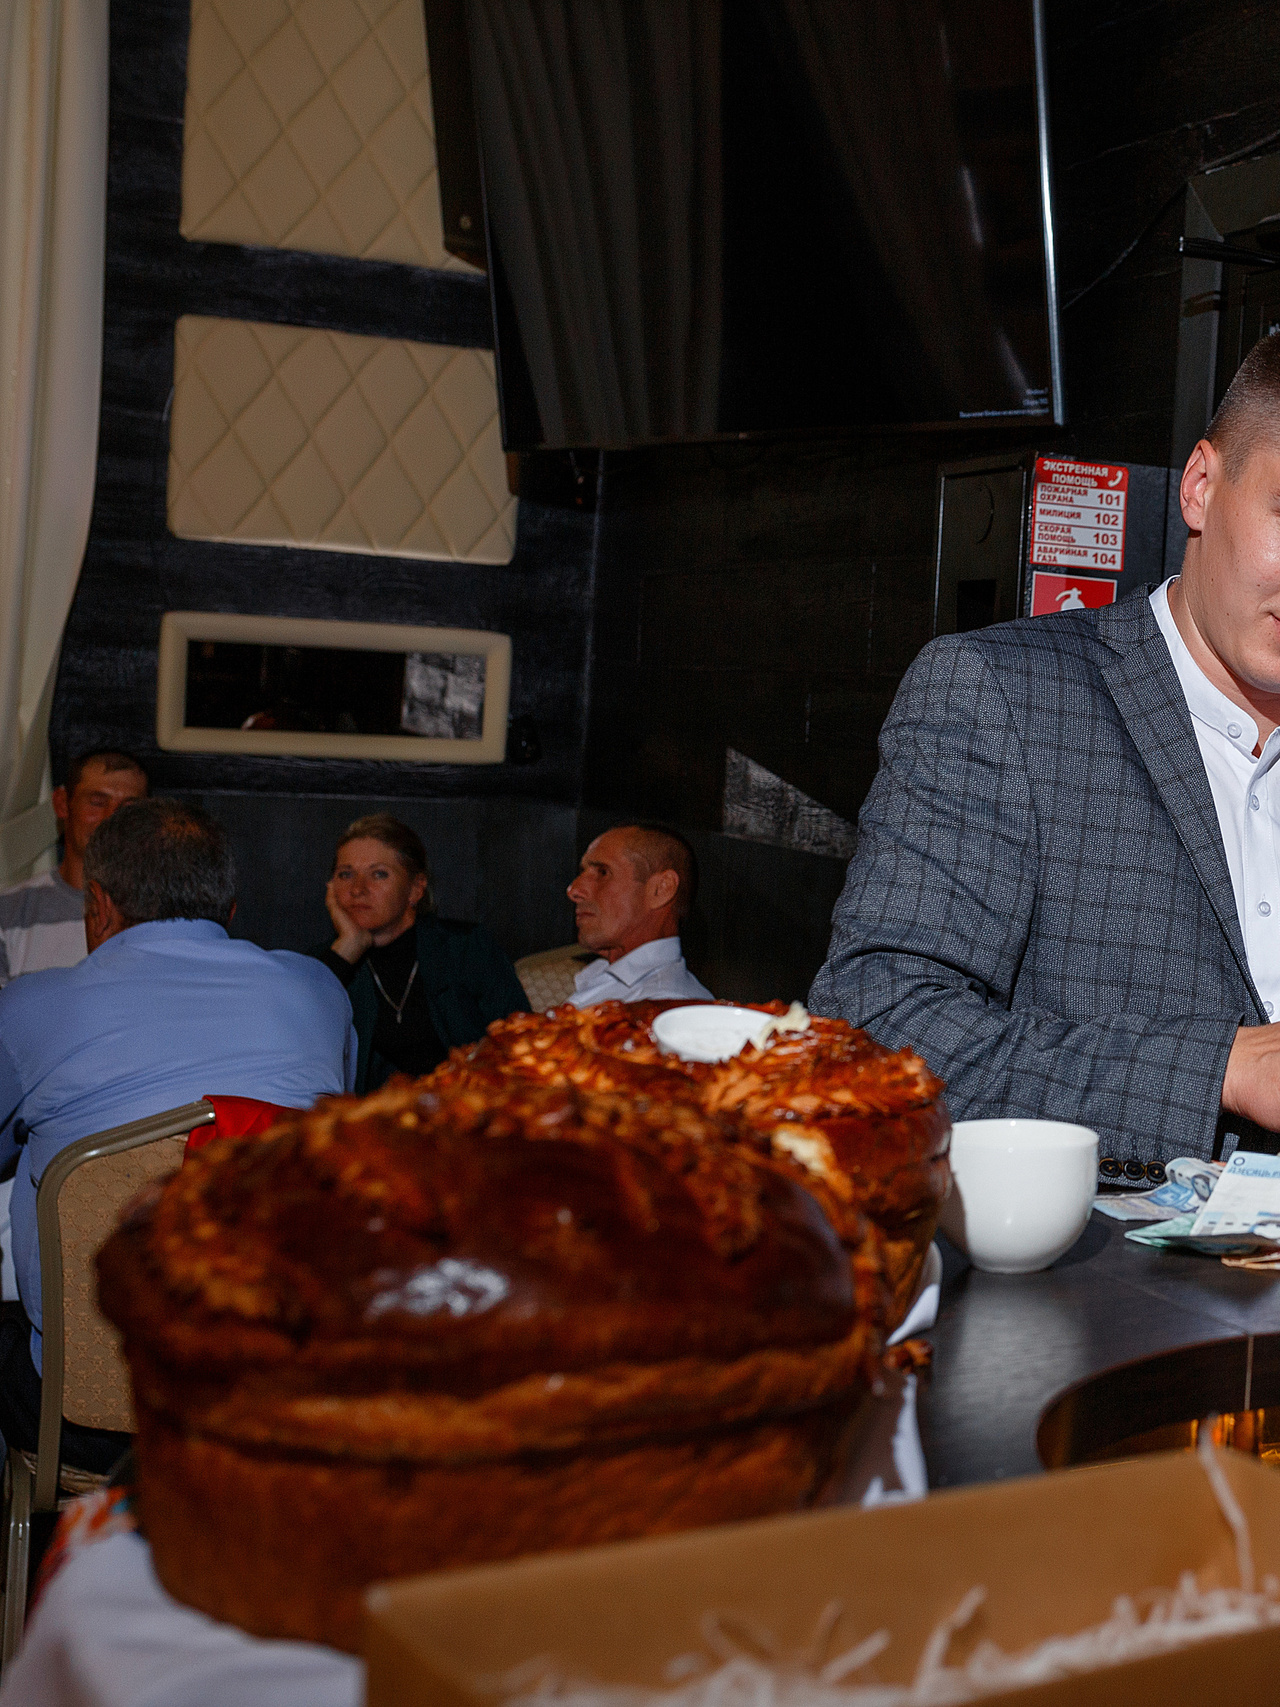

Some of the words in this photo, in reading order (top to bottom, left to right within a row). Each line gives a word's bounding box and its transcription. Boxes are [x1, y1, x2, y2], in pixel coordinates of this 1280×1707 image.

[1043, 460, 1108, 477] ЭКСТРЕННАЯ
[1052, 473, 1098, 488] ПОМОЩЬ
[1040, 484, 1088, 497] ПОЖАРНАЯ
[1040, 493, 1074, 504] ОХРАНА
[1097, 493, 1120, 506] 101
[1039, 509, 1081, 519] МИЛИЦИЯ
[1095, 513, 1119, 526] 102
[1038, 525, 1071, 534] СКОРАЯ
[1038, 533, 1076, 543] ПОМОЩЬ
[1093, 533, 1117, 546] 103
[1037, 546, 1088, 557] АВАРИЙНАЯ
[1036, 554, 1058, 563] ГАЗА
[1092, 553, 1116, 565] 104
